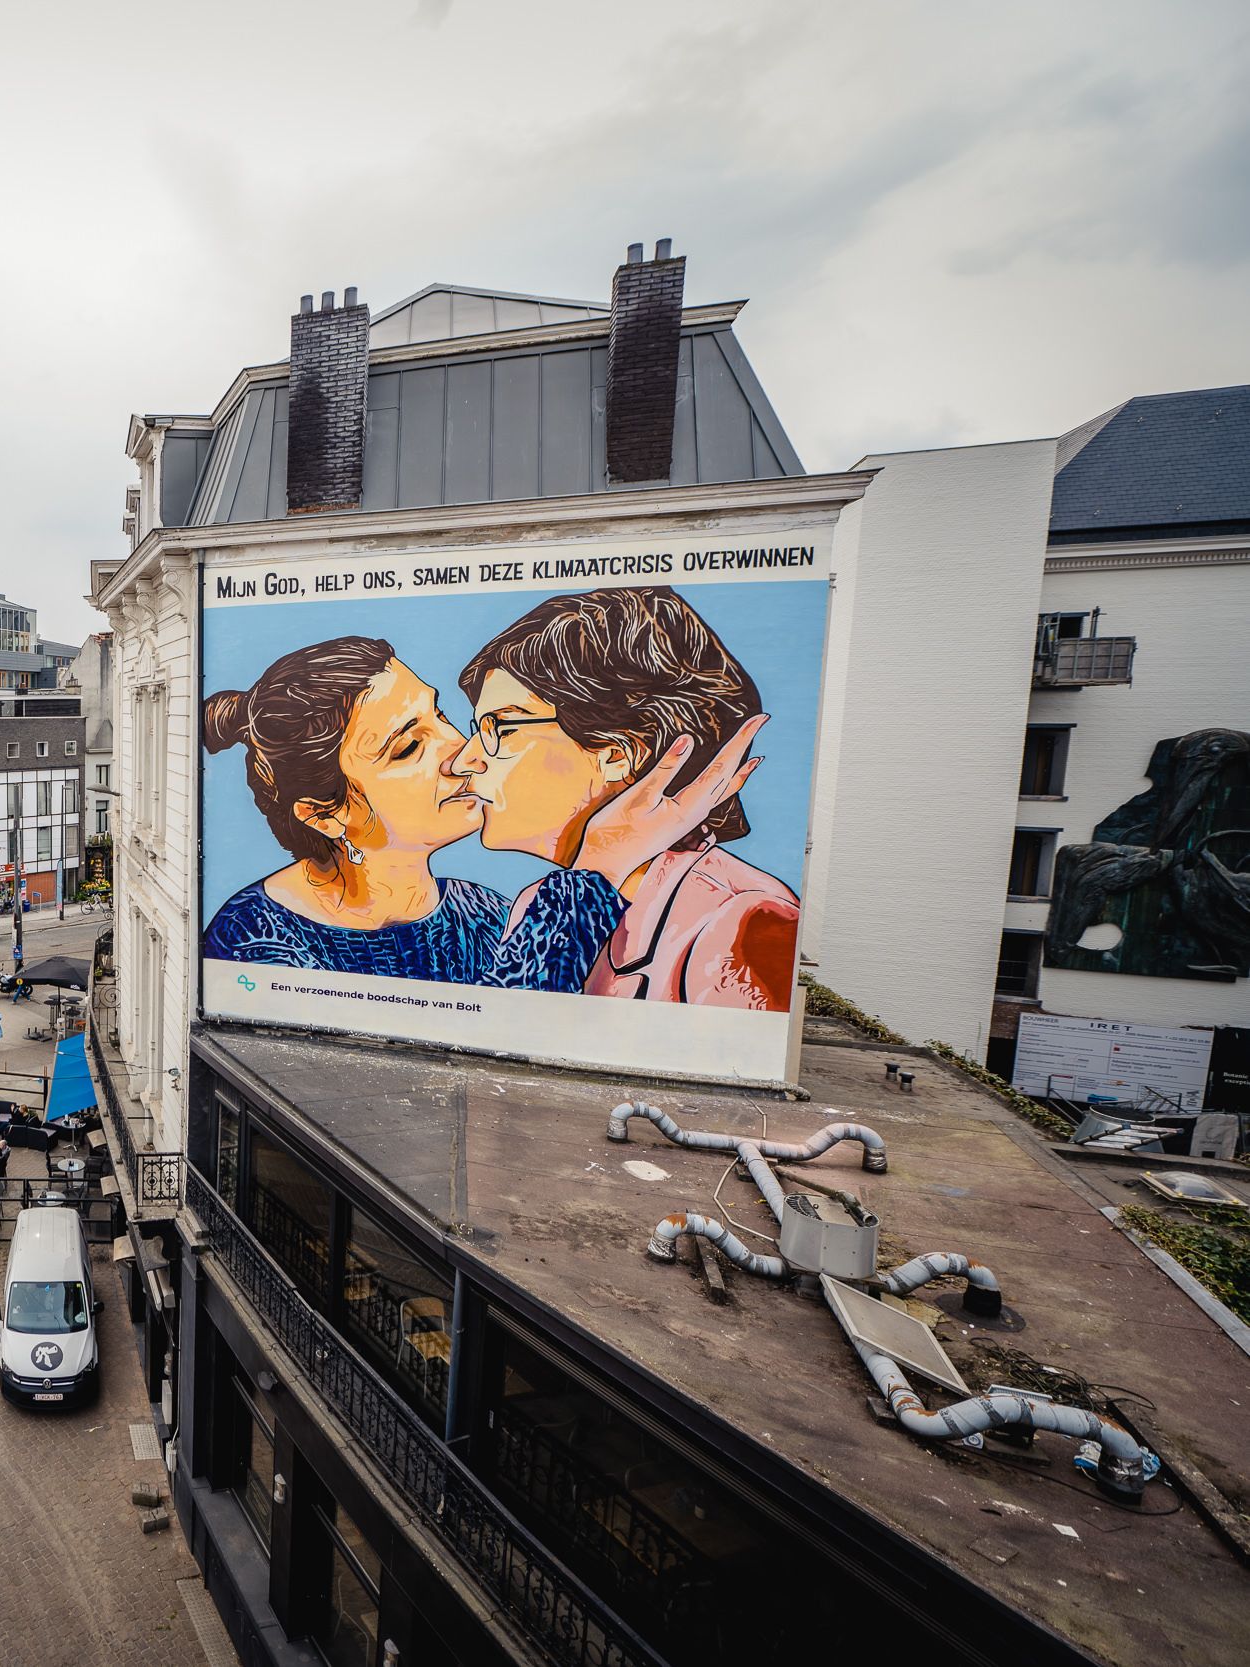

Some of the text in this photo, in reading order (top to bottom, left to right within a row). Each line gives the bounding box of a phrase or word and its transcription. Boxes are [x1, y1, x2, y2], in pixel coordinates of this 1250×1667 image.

[315, 573, 355, 593] HELP
[363, 570, 403, 590] ONS,
[413, 565, 470, 586] SAMEN
[479, 562, 524, 582] DEZE
[532, 553, 673, 579] KLIMAATCRISIS
[683, 547, 815, 572] OVERWINNEN
[271, 982, 482, 1012] Een verzoenende boodschap van Bolt
[1090, 1022, 1133, 1032] IRET
